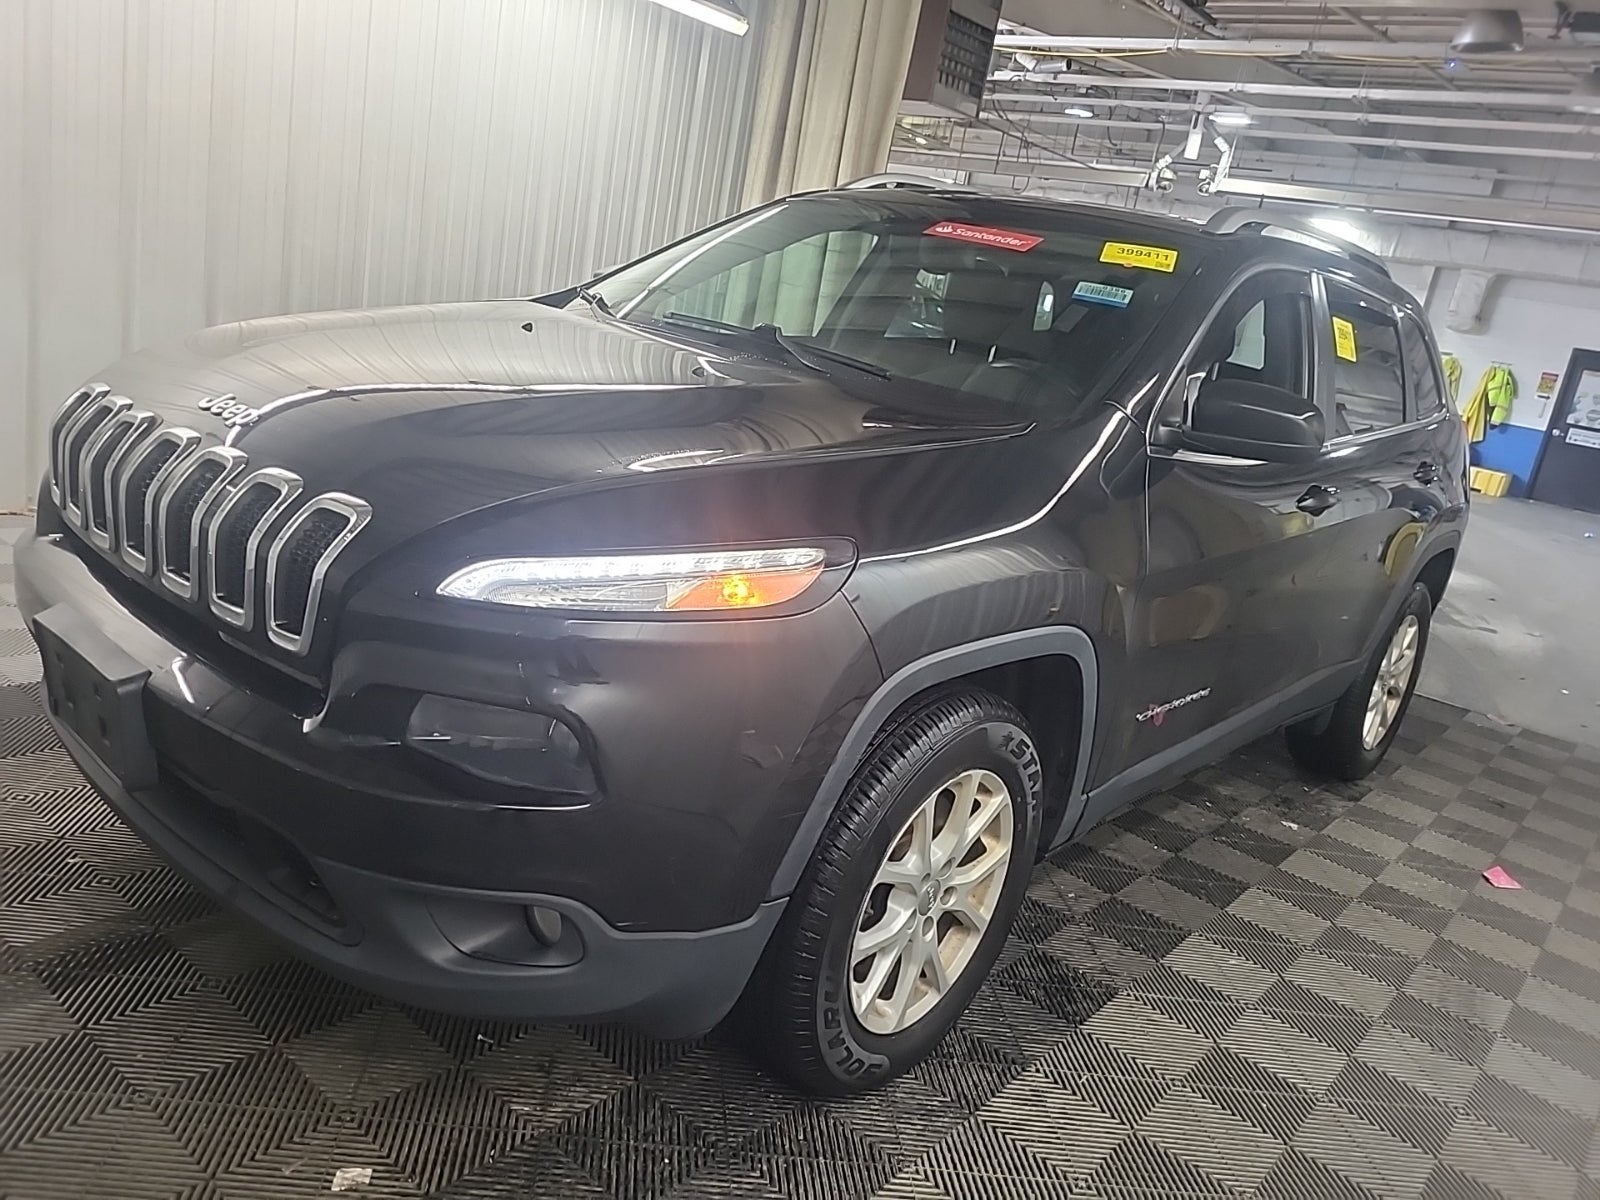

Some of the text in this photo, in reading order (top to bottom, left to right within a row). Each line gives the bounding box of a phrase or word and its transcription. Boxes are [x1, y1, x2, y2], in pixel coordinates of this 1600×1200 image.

[953, 228, 1027, 246] Santander
[1117, 247, 1169, 261] 399411
[198, 393, 259, 428] Jeep
